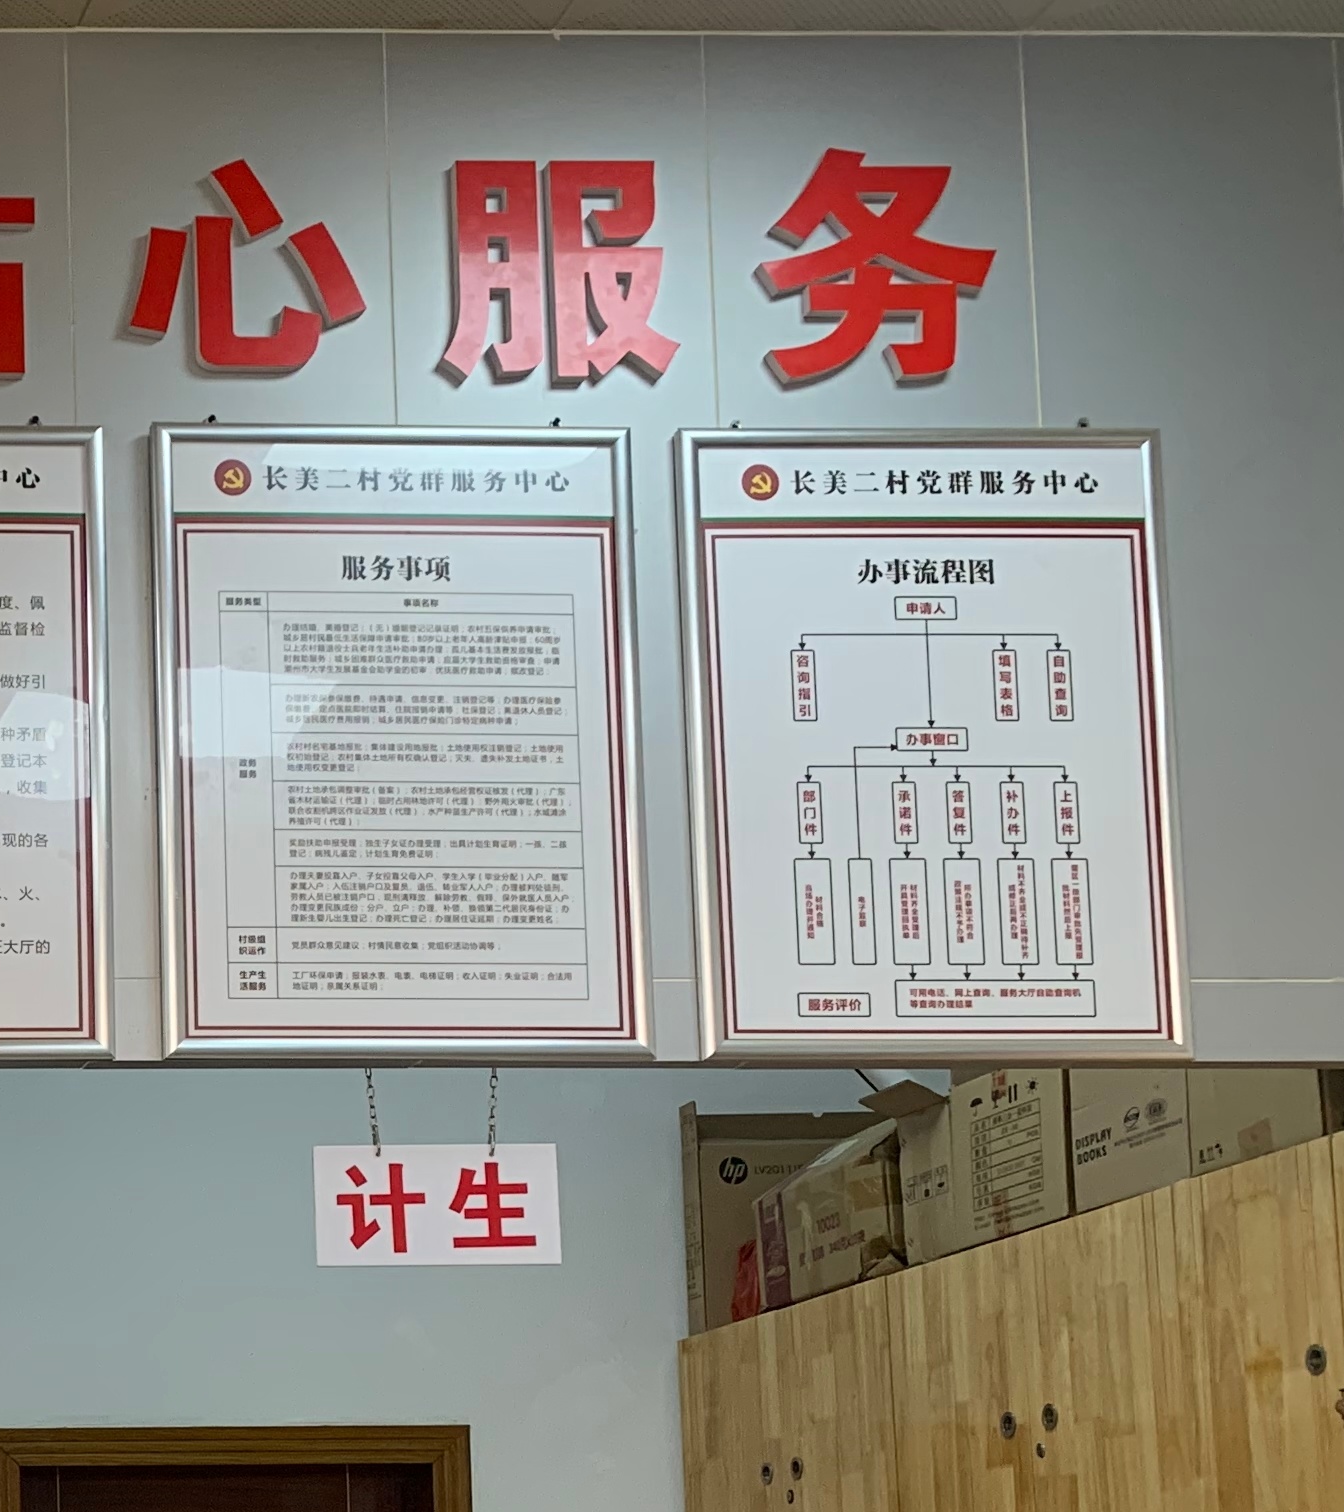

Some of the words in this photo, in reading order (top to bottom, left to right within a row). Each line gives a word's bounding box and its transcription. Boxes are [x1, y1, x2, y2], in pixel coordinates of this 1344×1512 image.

[263, 465, 571, 493] 长美二村党群服务中心
[793, 469, 1100, 497] 长美二村党群服务中心
[341, 555, 452, 582] 服务事项
[857, 558, 996, 586] 办事流程图
[906, 601, 946, 616] 申请人
[795, 654, 813, 718] 咨询指引
[999, 653, 1014, 718] 填写表格
[1053, 654, 1068, 718] 自助查询
[906, 732, 960, 747] 办事窗口
[802, 789, 818, 838] 部门件
[898, 789, 913, 837] 承诺件
[952, 789, 968, 838] 答复件
[1005, 789, 1021, 838] 补办件
[1059, 789, 1075, 837] 上报件
[807, 997, 862, 1012] 服务评价
[1075, 1127, 1112, 1150] DISPLAY
[1077, 1146, 1107, 1165] BOOKS
[723, 1158, 745, 1184] hp
[335, 1160, 538, 1255] 计生
